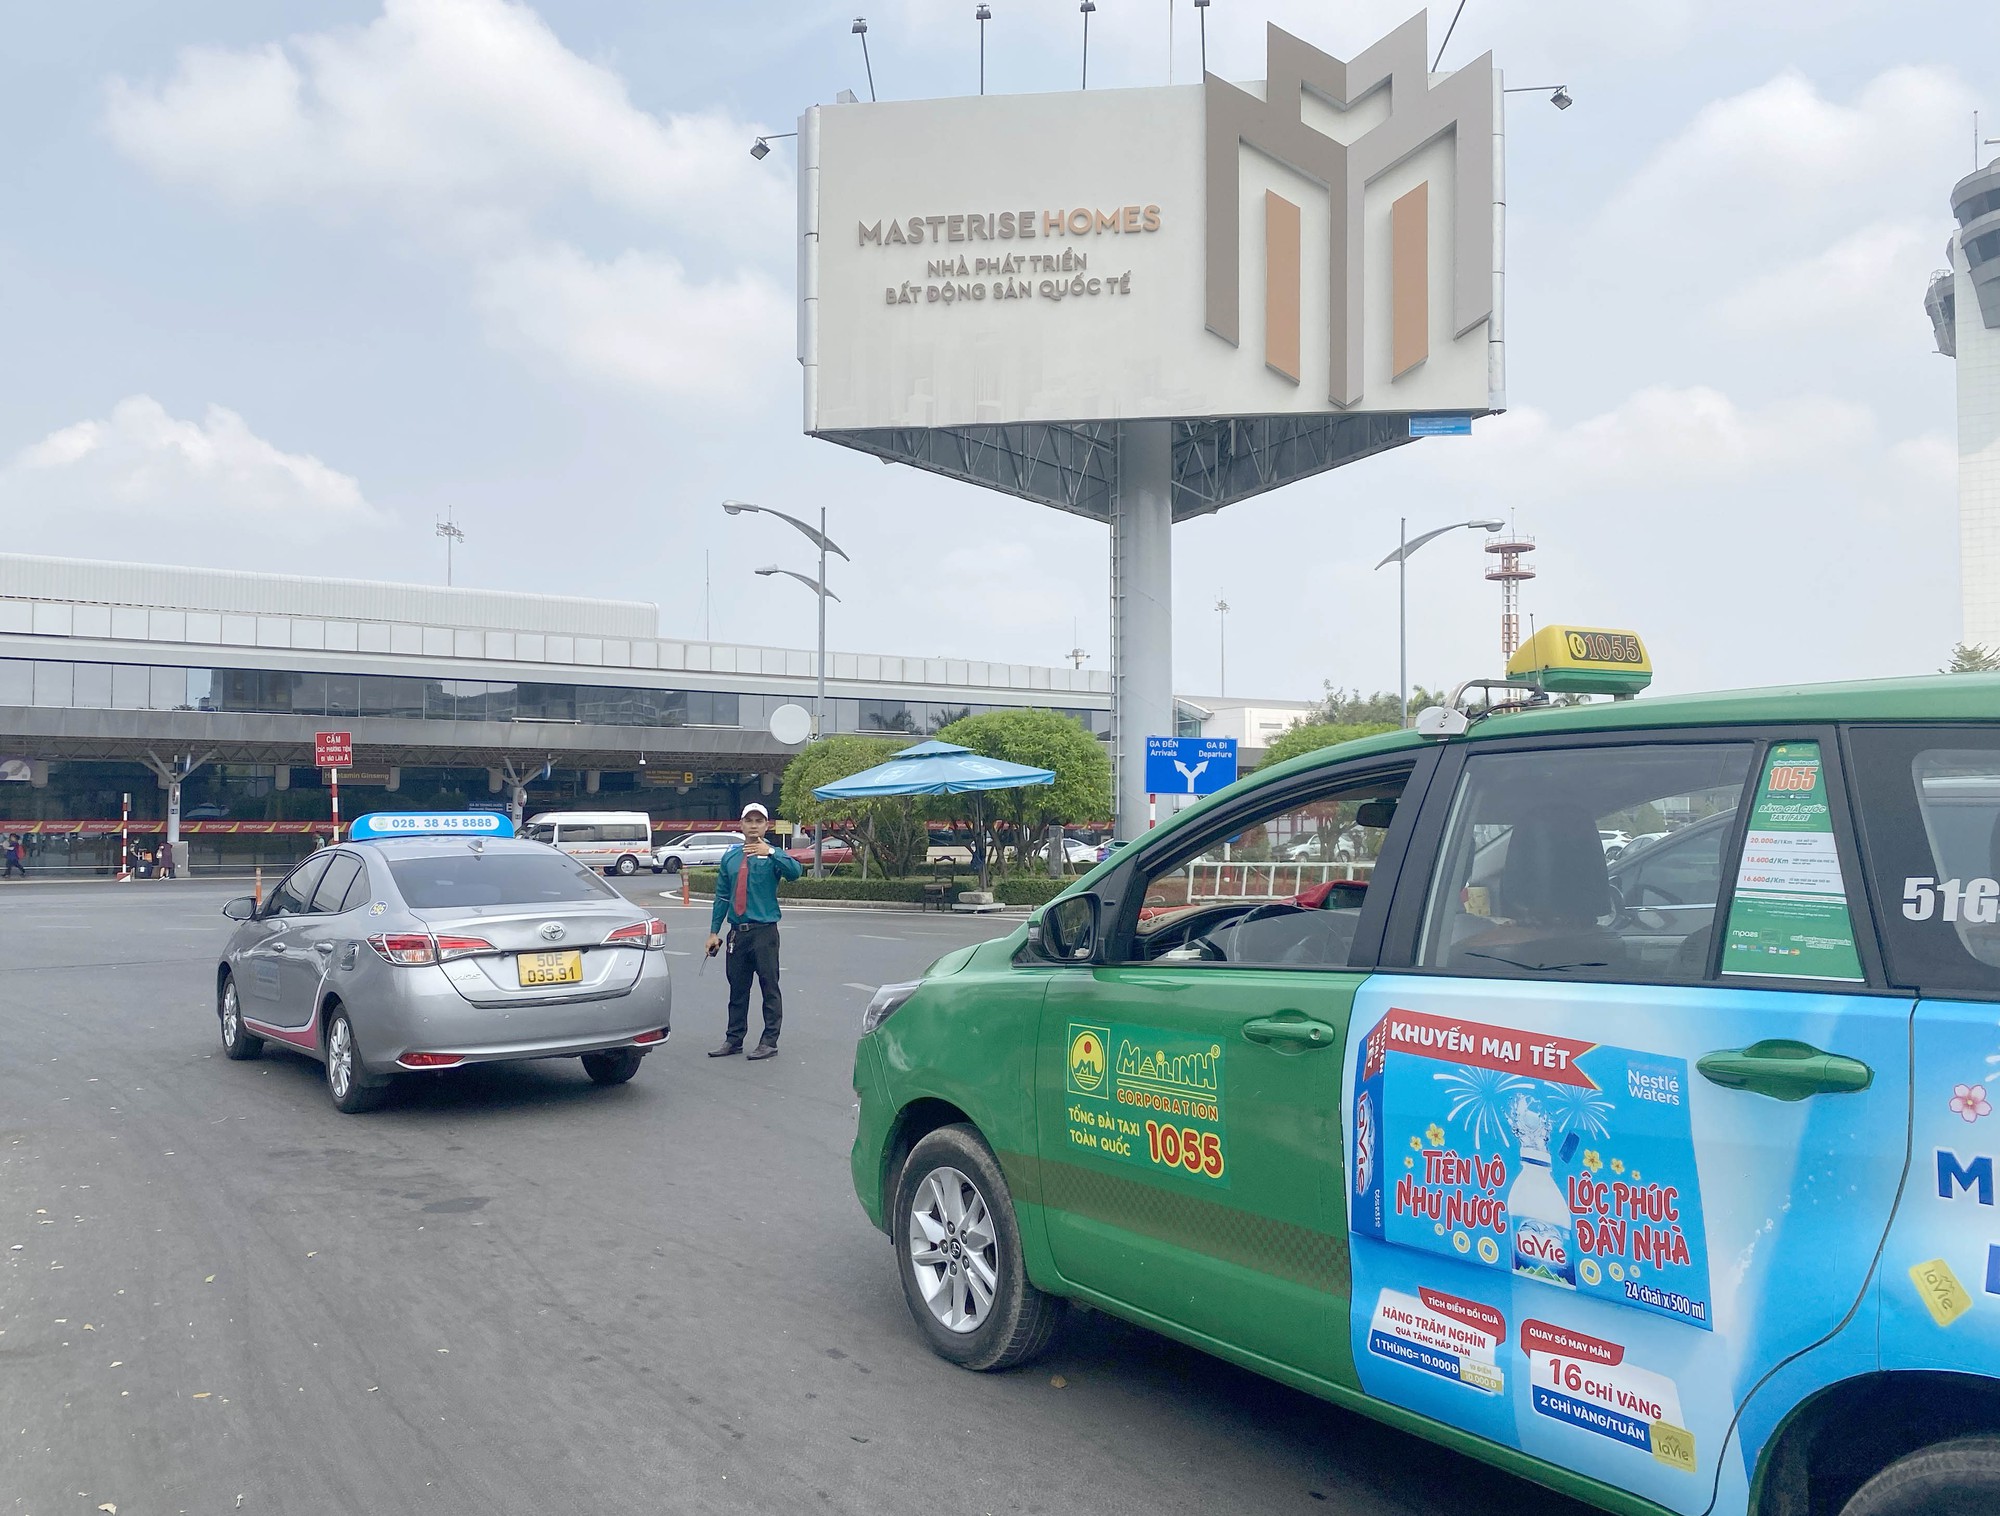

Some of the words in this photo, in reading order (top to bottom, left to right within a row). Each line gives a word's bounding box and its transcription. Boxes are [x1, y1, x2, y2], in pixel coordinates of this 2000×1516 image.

[858, 211, 1036, 246] MASTERISE
[1043, 205, 1161, 236] HOMES
[928, 254, 970, 277] NHÀ
[976, 252, 1026, 275] PHÁT
[1030, 247, 1087, 273] TRIỂN
[886, 281, 922, 304] BẤT
[927, 281, 986, 305] ĐỘNG
[993, 277, 1031, 300] SẢN
[1040, 272, 1100, 301] QUỐC
[1106, 270, 1131, 294] TẾ
[1585, 634, 1640, 662] 1055
[1150, 740, 1160, 748] GA
[1162, 738, 1178, 748] ĐẾN
[1199, 750, 1232, 758] Departure
[361, 772, 389, 780] Ginseng
[684, 772, 693, 783] B
[1768, 767, 1819, 790] 1055
[392, 819, 419, 828] 028.
[424, 819, 438, 828] 38
[444, 819, 458, 827] 45
[462, 818, 492, 827] 8888
[528, 967, 575, 983] 035.91
[537, 954, 563, 966] 50E
[1391, 1021, 1474, 1053] KHUYẾN
[1482, 1036, 1521, 1062] MẠI
[1530, 1042, 1570, 1070] TẾT
[1628, 1070, 1679, 1092] Nestlé
[1628, 1085, 1680, 1105] Waters
[1068, 1104, 1094, 1125] TỔNG
[1098, 1112, 1114, 1130] ĐÀI
[1118, 1119, 1140, 1137] TAXI
[1117, 1088, 1218, 1122] CORPORATION
[1070, 1129, 1096, 1148] TOÀN
[1101, 1135, 1130, 1157] QUỐC
[1146, 1120, 1224, 1179] 1055
[1422, 1150, 1471, 1185] TIỀN
[1474, 1153, 1506, 1190] VÔ
[1396, 1174, 1443, 1220] NHƯ
[1446, 1188, 1506, 1234] NƯỚC
[1568, 1170, 1610, 1215] LỘC
[1612, 1182, 1679, 1223] PHÚC
[1516, 1232, 1566, 1265] laVie
[1576, 1216, 1626, 1257] ĐẦY
[1633, 1224, 1691, 1270] NHÀ
[1625, 1281, 1639, 1300] 24
[1640, 1285, 1661, 1306] chai
[1662, 1294, 1670, 1309] x
[1670, 1294, 1690, 1315] 500
[1691, 1302, 1705, 1320] ml
[1924, 1268, 1953, 1310] laVie
[1428, 1297, 1445, 1309] TÍCH
[1446, 1302, 1466, 1314] ĐIỂM
[1467, 1308, 1481, 1319] ĐỔI
[1482, 1313, 1499, 1325] QUÀ
[1383, 1306, 1413, 1325] HÀNG
[1415, 1316, 1446, 1336] TRĂM
[1449, 1325, 1486, 1349] NGHÌN
[1396, 1326, 1411, 1337] QUÀ
[1413, 1331, 1433, 1345] TẶNG
[1435, 1338, 1451, 1350] HẤP
[1453, 1344, 1470, 1356] DẪN
[1375, 1338, 1380, 1348] 1
[1420, 1353, 1450, 1372] 10.000
[1530, 1328, 1553, 1341] QUAY
[1555, 1335, 1567, 1346] SỐ
[1568, 1340, 1588, 1353] MAY
[1590, 1345, 1611, 1360] MẮN
[1549, 1358, 1582, 1391] 16
[1585, 1380, 1613, 1402] CHỈ
[1616, 1390, 1662, 1419] VÀNG
[1541, 1395, 1548, 1406] 2
[1550, 1400, 1571, 1414] CHỈ
[1573, 1405, 1645, 1441] VÀNG/TUẦN
[1658, 1441, 1689, 1461] laVie
